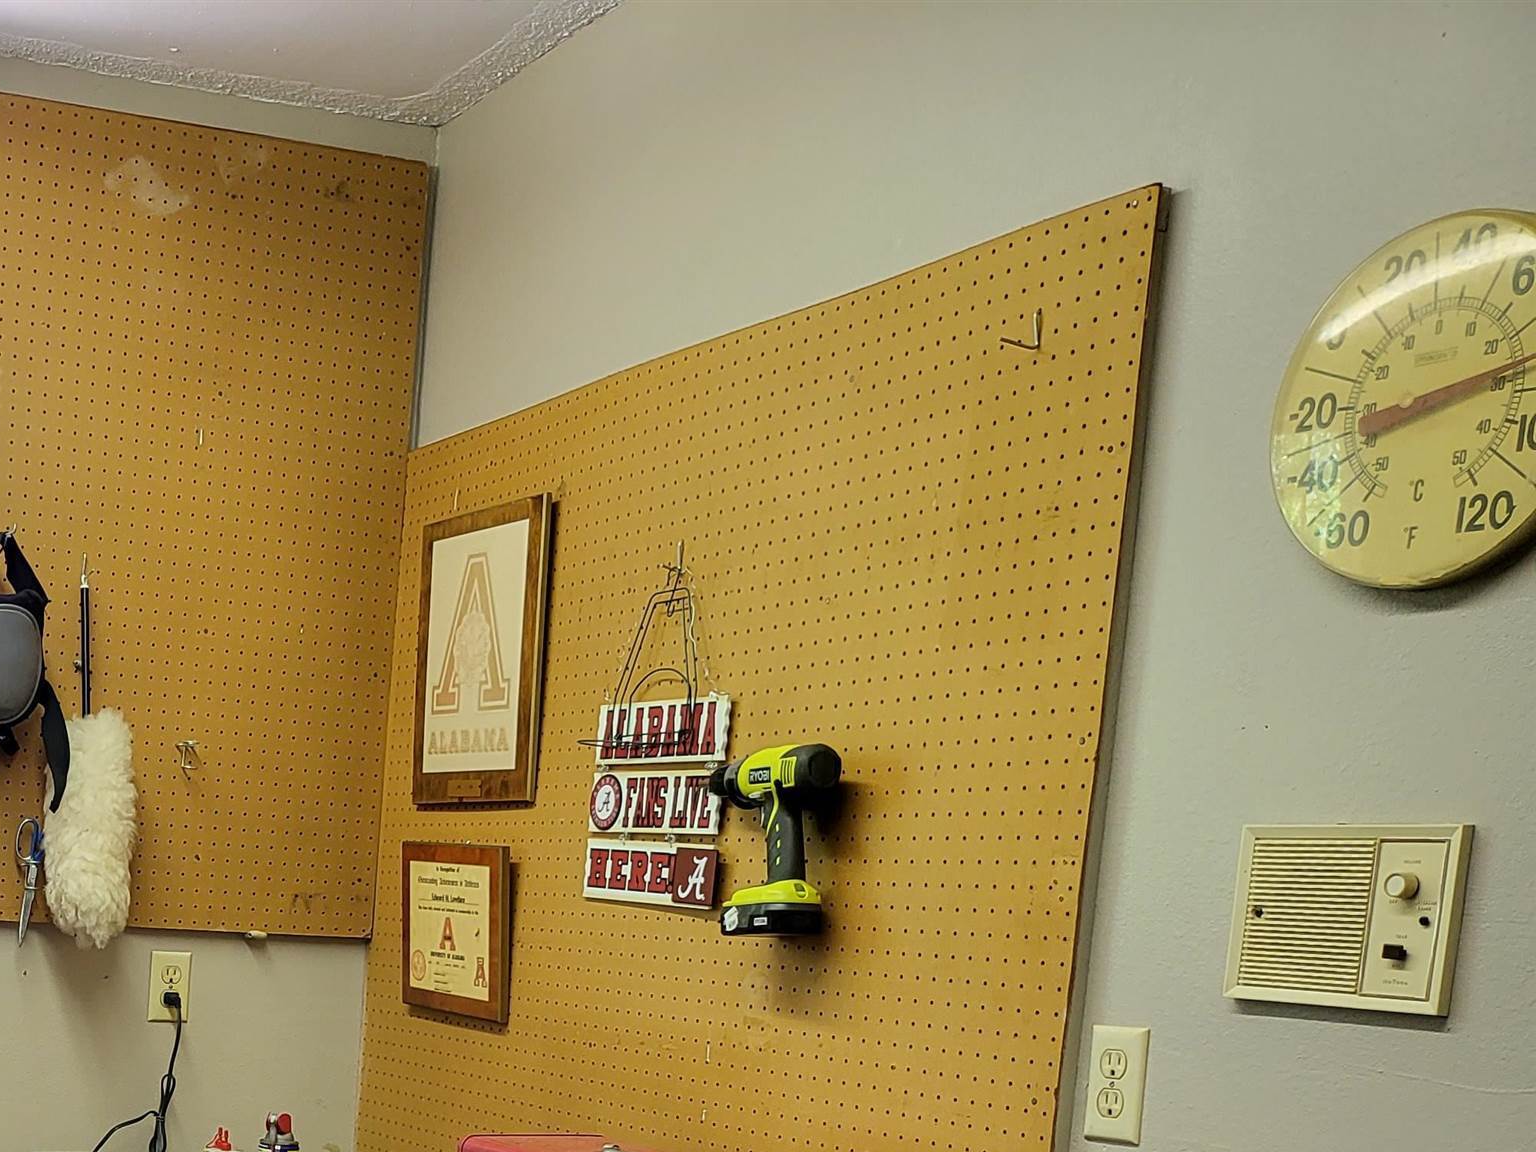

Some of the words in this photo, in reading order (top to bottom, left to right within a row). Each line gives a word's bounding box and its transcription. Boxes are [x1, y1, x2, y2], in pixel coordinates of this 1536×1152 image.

[1484, 339, 1499, 355] 20
[1289, 392, 1337, 433] -20
[1476, 418, 1491, 434] 40
[1452, 449, 1467, 466] 50
[1455, 490, 1516, 534] 120
[427, 727, 509, 755] ALABAMA
[600, 701, 717, 760] ALABAMA
[749, 768, 771, 784] RYOBI
[622, 776, 669, 828] FANS
[669, 775, 712, 829] LIVE
[587, 848, 676, 895] HERE!
